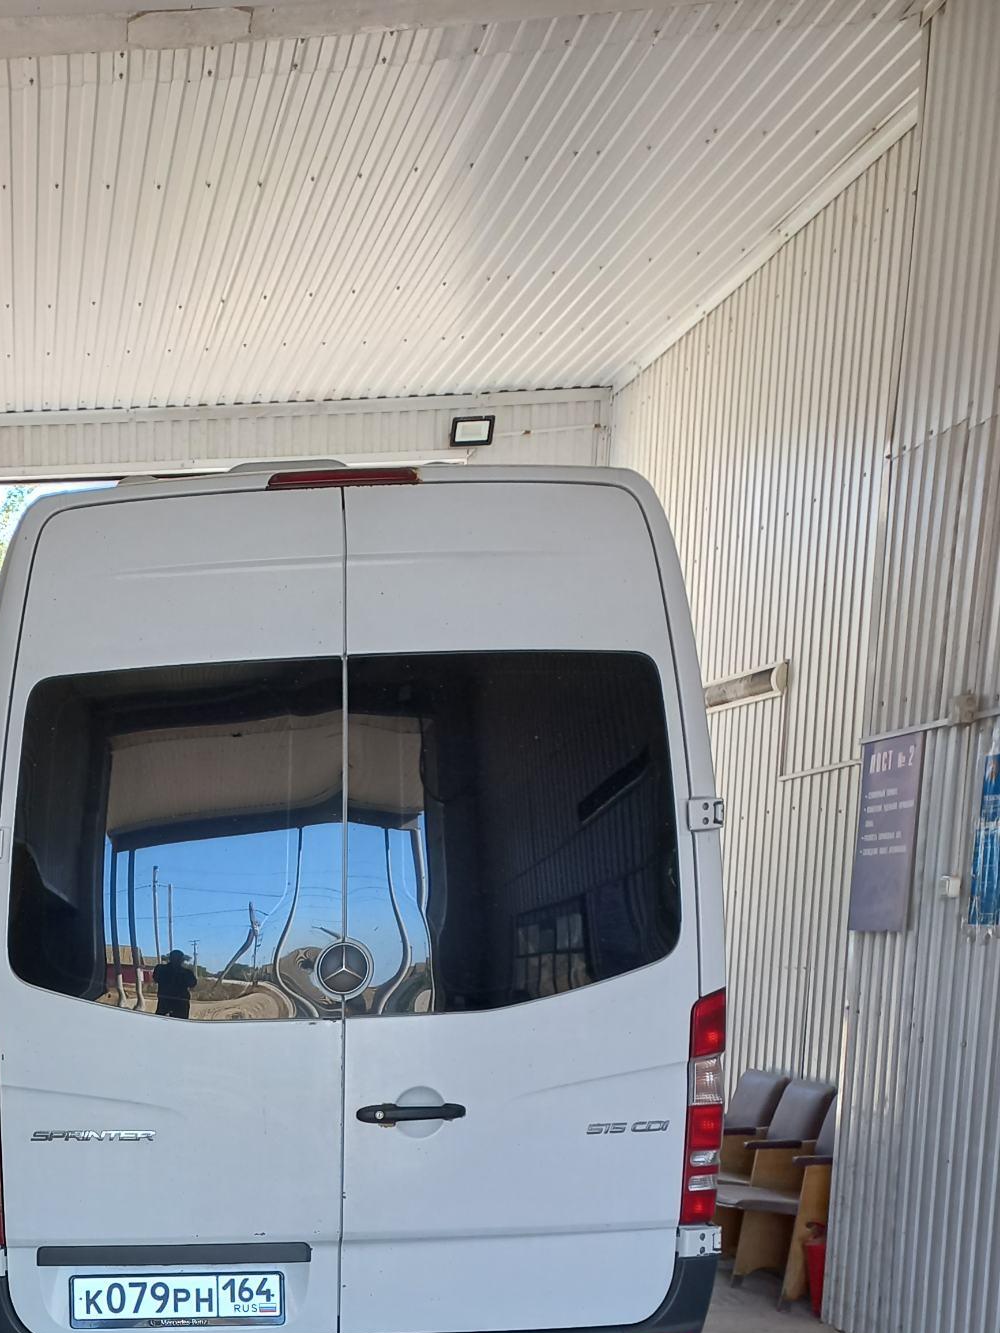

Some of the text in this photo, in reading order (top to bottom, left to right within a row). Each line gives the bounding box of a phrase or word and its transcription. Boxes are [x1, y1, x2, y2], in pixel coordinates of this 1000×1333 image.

[869, 750, 893, 774] ПОСТ
[907, 744, 916, 767] 2
[586, 1119, 670, 1135] 515 CDI
[30, 1129, 156, 1142] SPRINTER
[85, 1276, 273, 1315] К079РН 164
[233, 1303, 258, 1313] RUS
